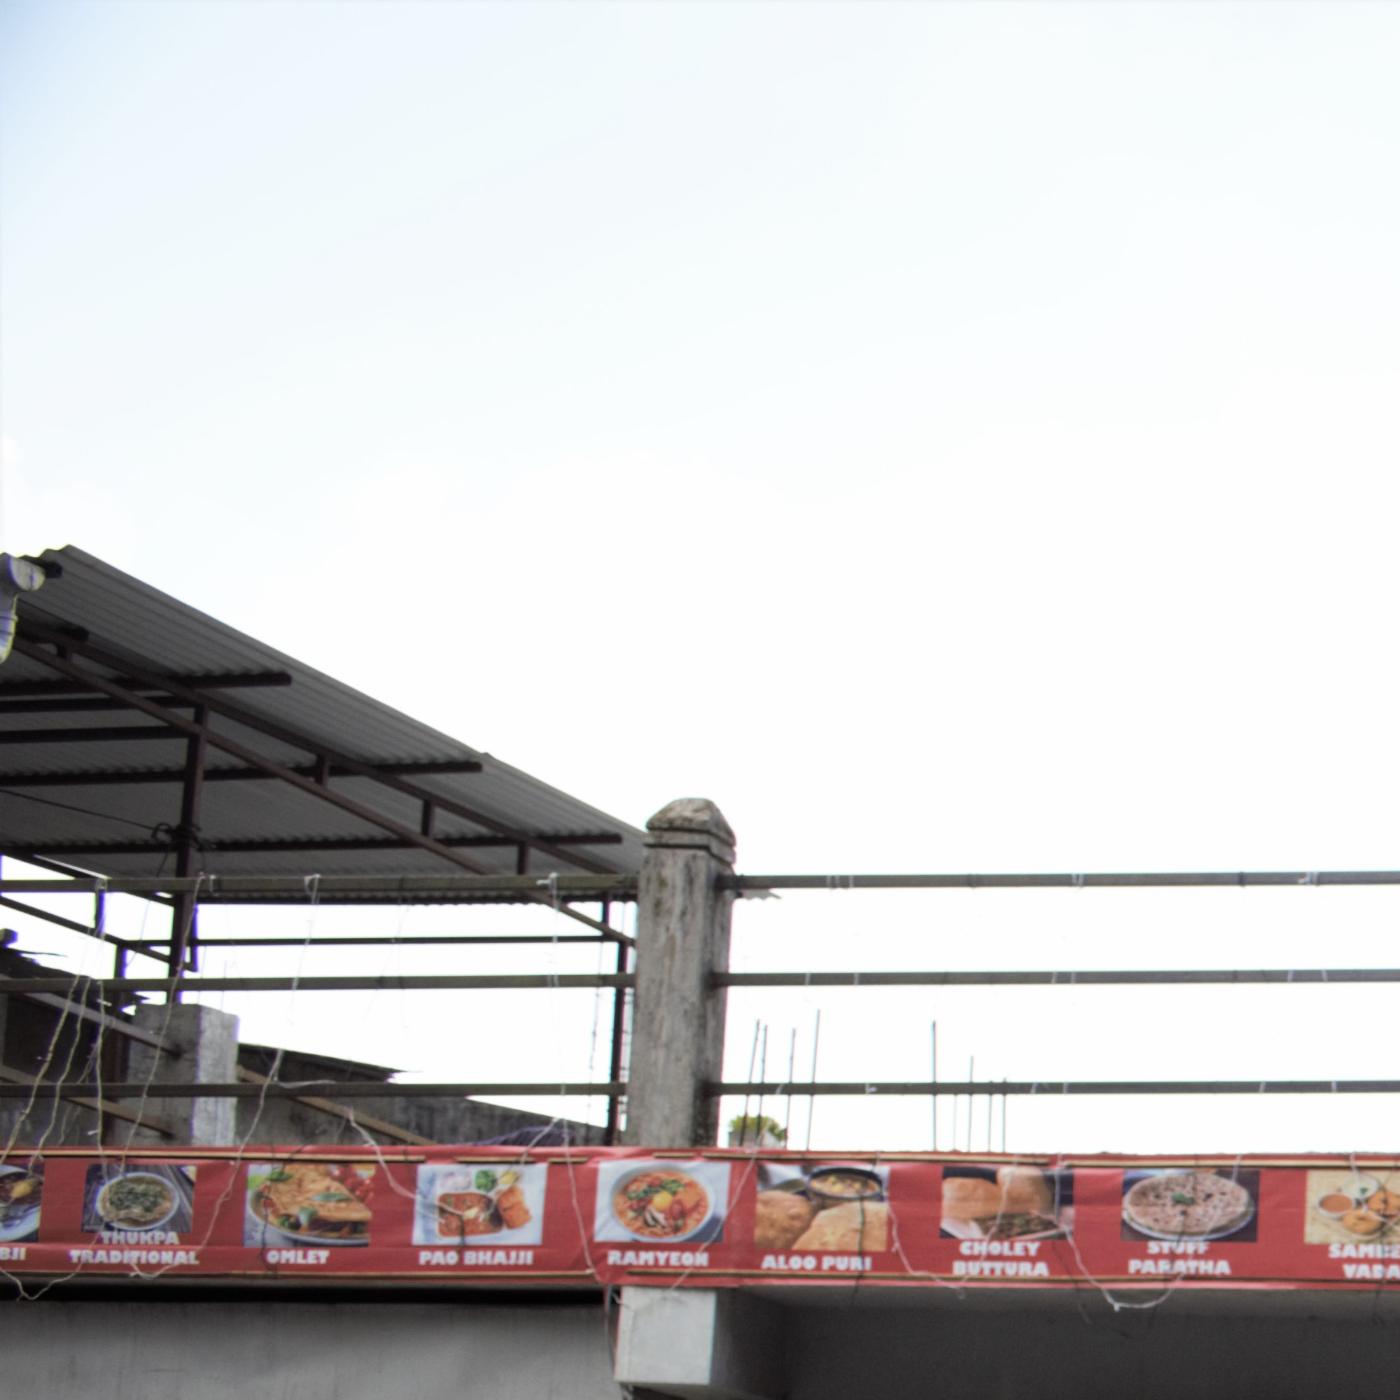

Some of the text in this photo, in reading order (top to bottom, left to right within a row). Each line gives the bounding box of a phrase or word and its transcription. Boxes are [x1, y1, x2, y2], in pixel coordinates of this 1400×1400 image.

[101, 1231, 180, 1245] THUKPA
[959, 1241, 1041, 1256] CHOLEY
[1147, 1241, 1209, 1255] STUFF
[69, 1250, 200, 1265] TRADITIONAL
[266, 1250, 330, 1265] OMLET
[419, 1250, 534, 1266] PAO BHAJJI
[607, 1250, 709, 1267] RAMYEON
[761, 1255, 872, 1271] ALOO PURI
[952, 1261, 1049, 1277] BUTTURA
[1128, 1260, 1232, 1275] PARATHA
